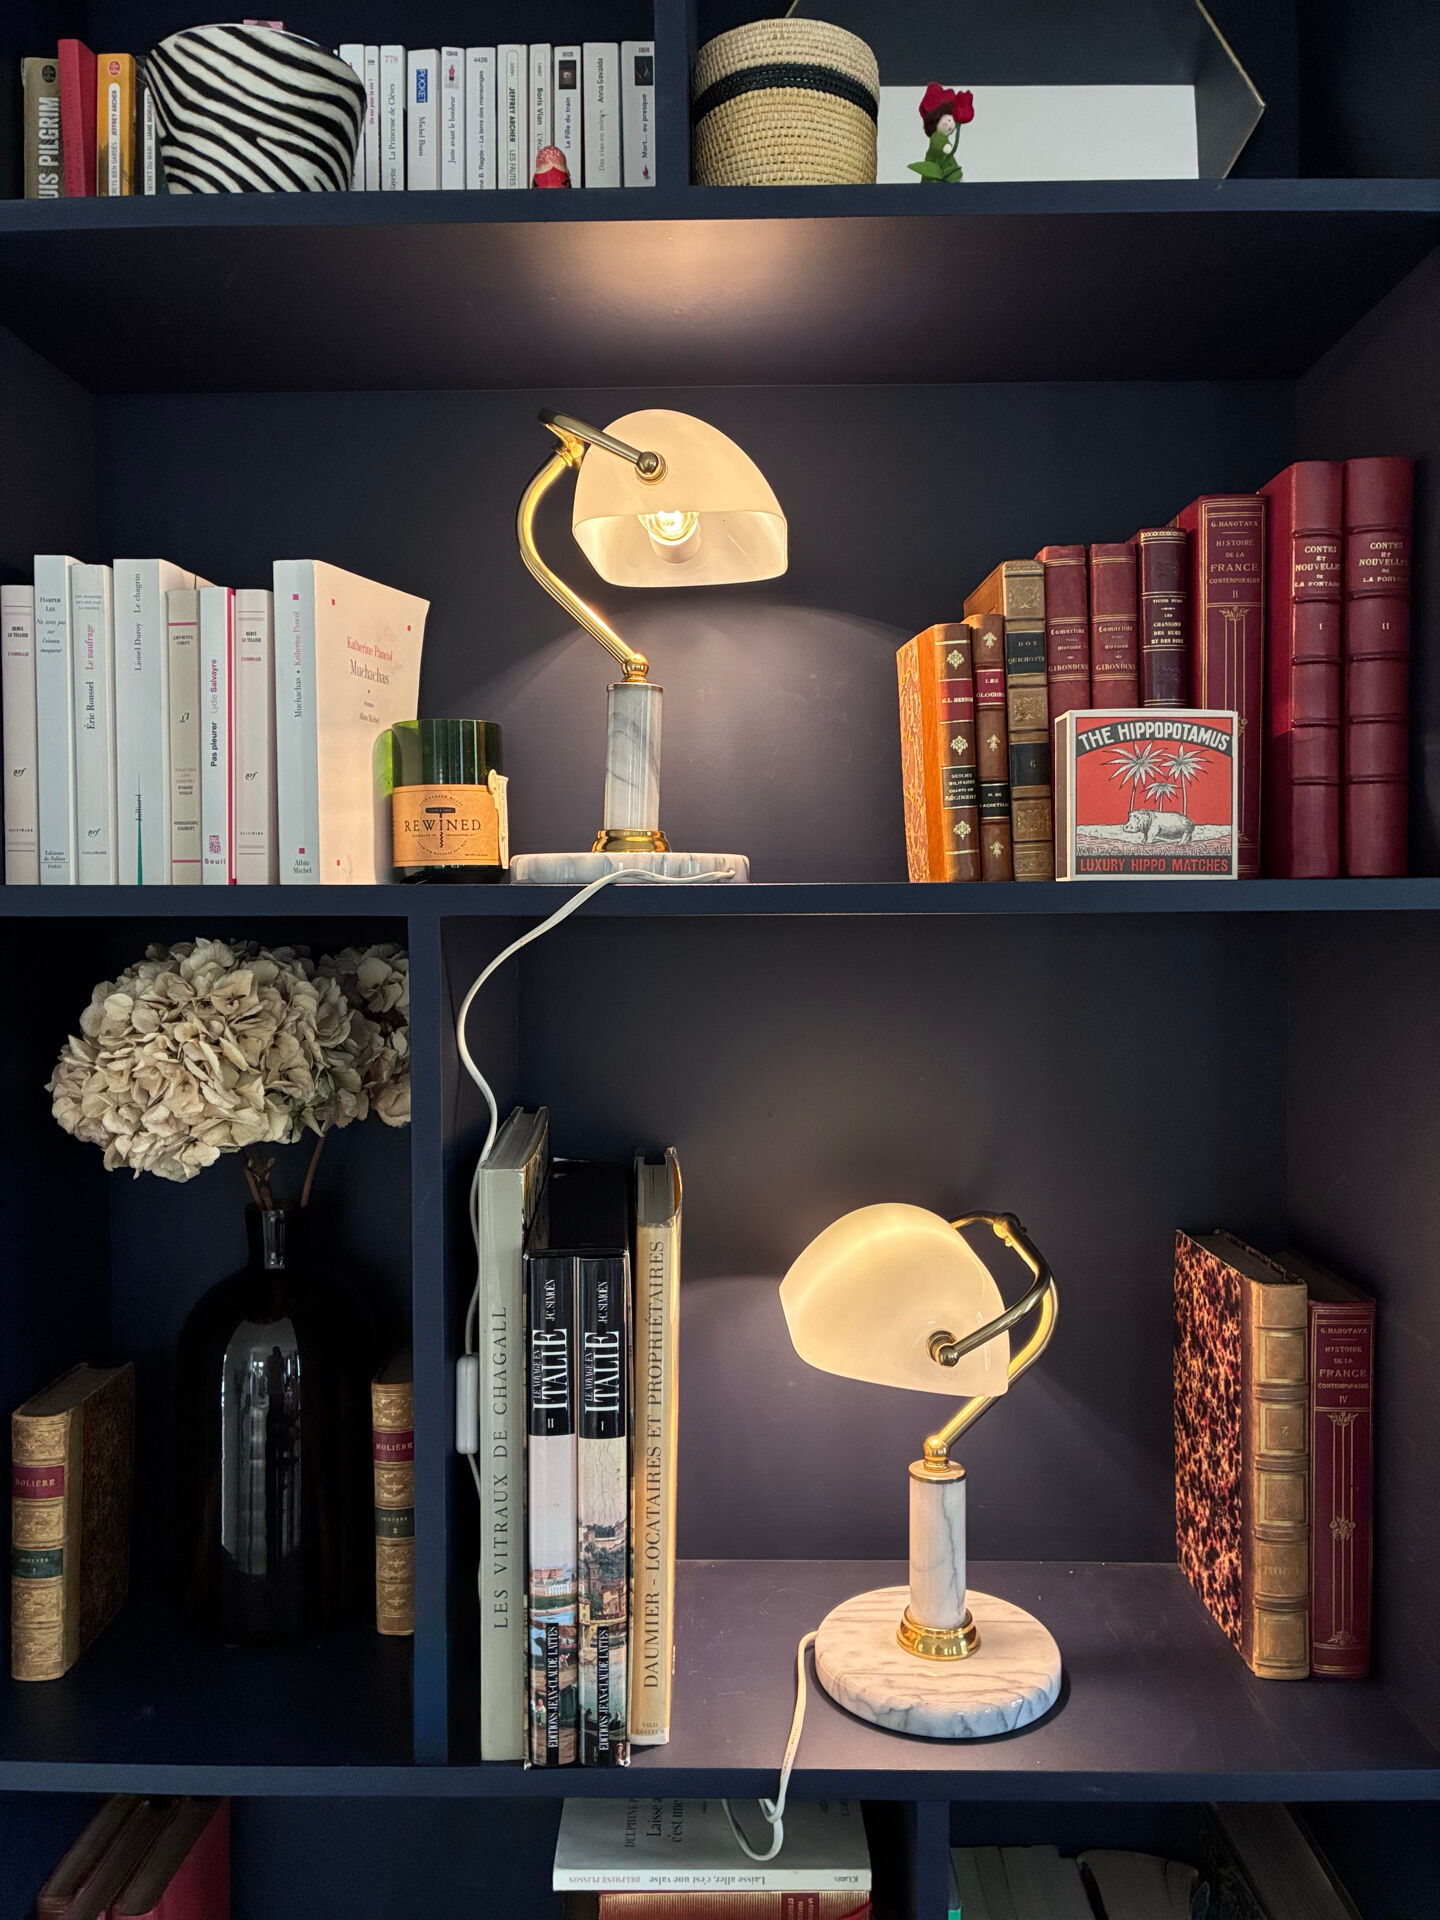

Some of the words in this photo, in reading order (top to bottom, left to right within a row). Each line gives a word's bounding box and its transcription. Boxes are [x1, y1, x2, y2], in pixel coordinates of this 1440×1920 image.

[384, 55, 399, 63] 778
[388, 82, 396, 106] Clèves
[416, 68, 428, 103] POCKET
[478, 70, 486, 106] mensonges
[388, 106, 396, 116] de
[448, 96, 456, 122] bonheur
[508, 87, 516, 114] JEFFREY
[38, 96, 59, 167] PILGRIM
[508, 116, 516, 143] ARCHER
[564, 114, 571, 124] du
[388, 118, 396, 150] Princesse
[448, 130, 456, 148] avant
[478, 136, 484, 144] La
[564, 140, 571, 148] La
[146, 161, 153, 170] DU
[388, 151, 396, 160] La
[448, 149, 456, 164] Juste
[509, 164, 517, 188] FAUTES
[1210, 563, 1259, 572] FRANCE
[133, 573, 142, 603] chagrin
[133, 604, 141, 614] Le
[292, 611, 300, 632] Pancol
[86, 624, 96, 659] naufrage
[134, 622, 144, 644] Duroy
[134, 645, 142, 672] Lionel
[292, 634, 300, 666] Katherine
[346, 636, 374, 656] Katherine
[374, 645, 393, 662] Pancol
[1008, 656, 1046, 664] QUICHOTTE
[85, 659, 94, 671] Le
[210, 659, 219, 693] Salvayre
[350, 658, 390, 686] Muchachas
[1048, 663, 1089, 672] GIRONDINS
[1096, 662, 1136, 671] GIRONDINS
[86, 681, 95, 710] Roussel
[210, 694, 219, 714] Lydie
[294, 677, 302, 718] Muchachas
[84, 712, 95, 730] Éric
[210, 722, 218, 750] pleurer
[1078, 726, 1114, 751] THE
[1118, 722, 1231, 751] HIPPOPOTAMUS
[404, 819, 482, 832] REWINED
[1080, 858, 1126, 872] LUXURY
[1131, 858, 1166, 872] HIPPO
[1172, 858, 1229, 872] MATCHES
[645, 1241, 664, 1407] PROPRIÉTAIRES
[492, 1306, 508, 1416] CHAGALL
[584, 1352, 594, 1360] EN
[532, 1328, 567, 1412] ITALIE
[533, 1359, 542, 1388] VOYAGE
[584, 1331, 620, 1414] ITALIE
[584, 1360, 594, 1390] VOYAGE
[1320, 1369, 1368, 1378] FRANCE
[533, 1389, 541, 1399] LE
[584, 1391, 594, 1402] LE
[1340, 1396, 1348, 1404] IV
[648, 1414, 662, 1440] ET
[493, 1430, 508, 1458] DE
[645, 1446, 662, 1572] LOCATAIRES
[493, 1474, 508, 1575] VITRAUX
[494, 1589, 508, 1629] LES
[644, 1590, 660, 1689] DAUMIER
[548, 1658, 558, 1712] JEAN-CLAUDE
[598, 1660, 609, 1714] JEAN-CLAUDE
[646, 1804, 664, 1836] Laisse
[672, 1799, 684, 1818] une
[624, 1803, 638, 1848] DELPHINE
[667, 1820, 684, 1843] c'est
[648, 1876, 672, 1885] valse
[692, 1876, 711, 1885] c'est
[713, 1876, 736, 1885] aller,
[738, 1876, 766, 1884] Laisse
